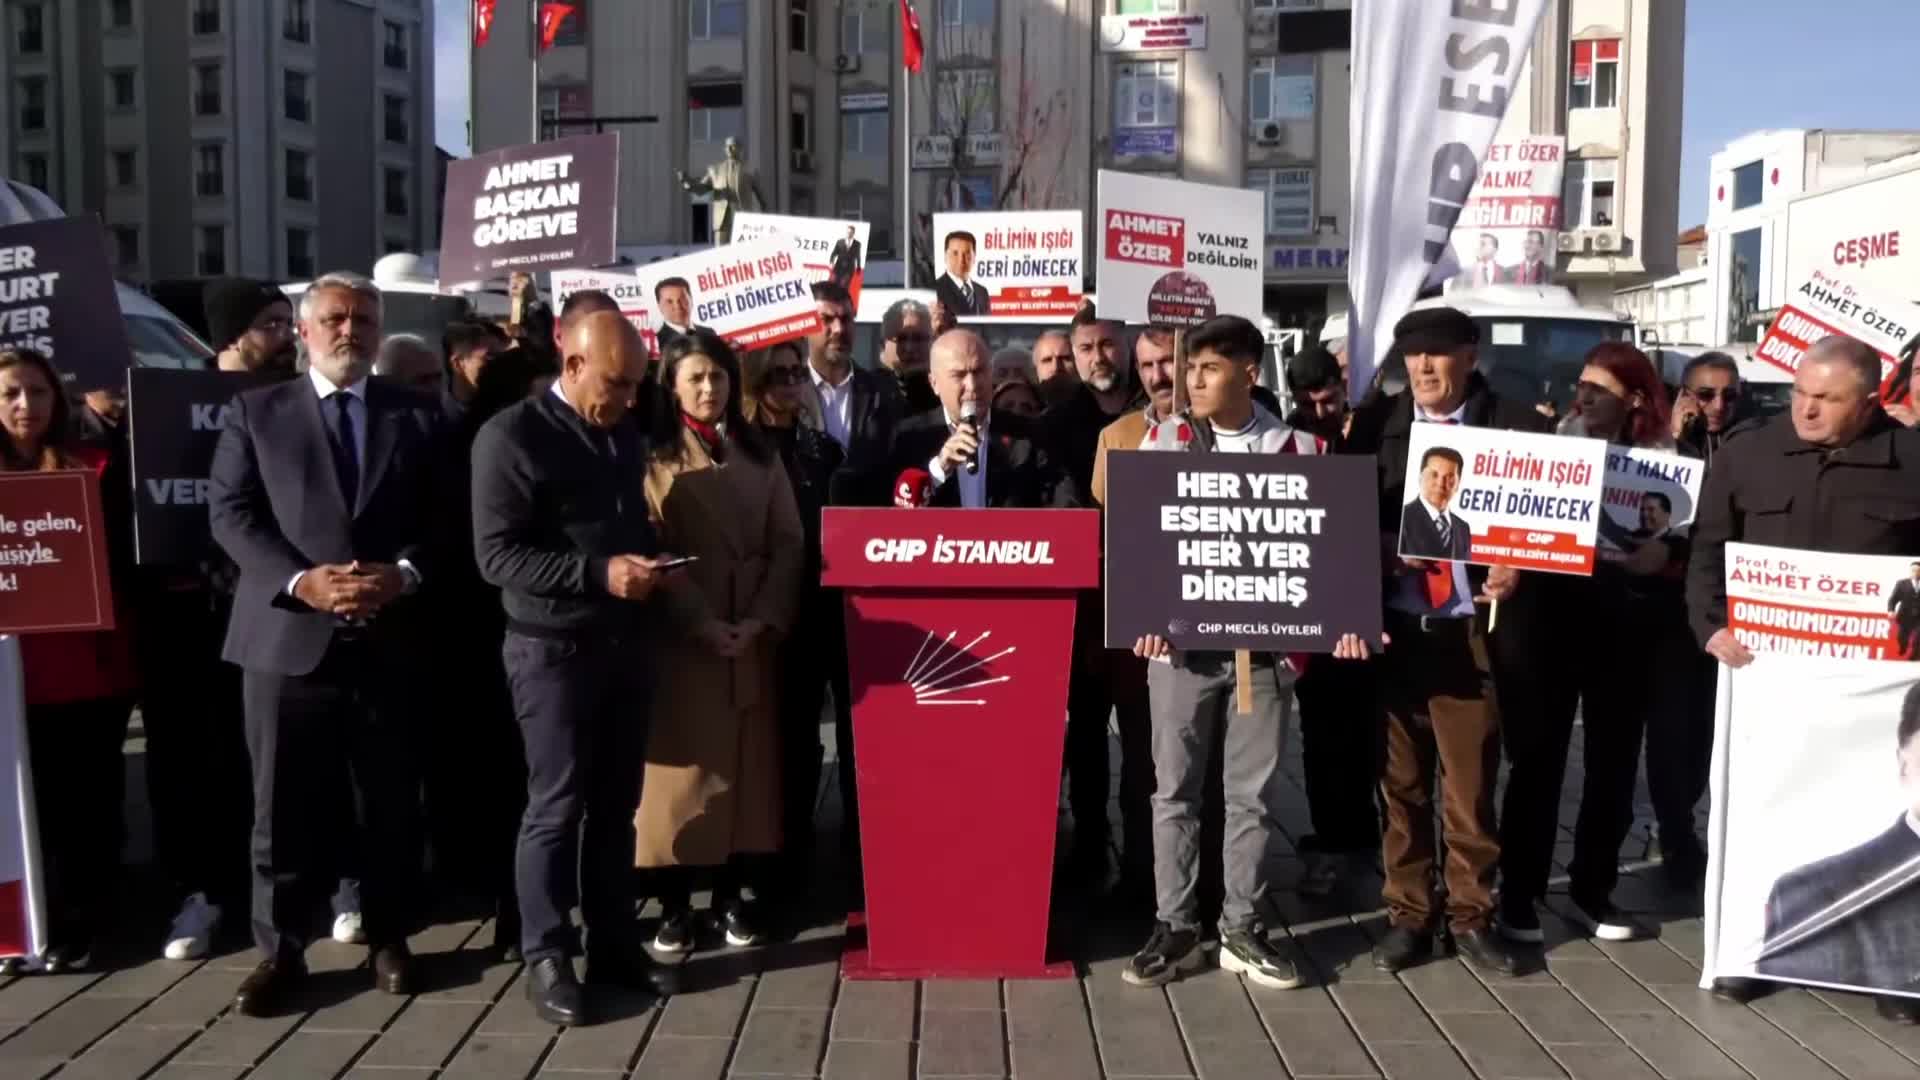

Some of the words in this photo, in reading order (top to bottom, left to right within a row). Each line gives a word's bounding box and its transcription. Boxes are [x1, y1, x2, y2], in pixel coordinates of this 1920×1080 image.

[1518, 139, 1559, 161] ÖZER
[484, 155, 573, 190] AHMET
[1481, 170, 1533, 188] ALNIZ
[474, 182, 580, 220] BAŞKAN
[473, 211, 578, 247] GÖREVE
[984, 227, 1037, 250] BİLİMİN
[1041, 228, 1073, 253] IŞIĞI
[1109, 213, 1182, 237] AHMET
[1197, 231, 1249, 249] YALNIZ
[1117, 235, 1172, 262] ÖZER
[1187, 250, 1258, 270] DEĞİLDİR!
[696, 258, 756, 292] BİLİMİN
[757, 250, 793, 280] IŞIĞI
[976, 255, 1009, 278] GERİ
[1012, 254, 1078, 277] DÖNECEK
[696, 293, 733, 322] GERİ
[735, 278, 807, 315] DÖNECEK
[1798, 280, 1862, 317] AHMET
[1861, 306, 1908, 342] ÖZER
[1472, 449, 1544, 482] BİLİMİN
[1548, 459, 1592, 488] IŞIĞI
[1637, 458, 1692, 486] HALKI
[1176, 471, 1241, 499] HER
[1245, 473, 1309, 501] YER
[1458, 485, 1504, 514] GERİ
[1505, 487, 1594, 523] DÖNECEK
[23, 511, 83, 537] gelen,
[1160, 504, 1327, 535] ESENYURT
[864, 538, 927, 563] CHP
[932, 533, 1055, 565] İSTANBUL
[1526, 531, 1556, 545] CHP
[1177, 539, 1242, 567] HER
[1247, 541, 1311, 569] YER
[1181, 568, 1309, 608] DİRENİŞ
[1729, 567, 1811, 591] AHMET
[1816, 574, 1881, 597] ÖZER
[1197, 623, 1223, 635] CHP
[1225, 621, 1269, 635] MECLİS
[1271, 621, 1323, 636] ÜYELERİ
[1733, 601, 1892, 640] ONURUMUZDUR
